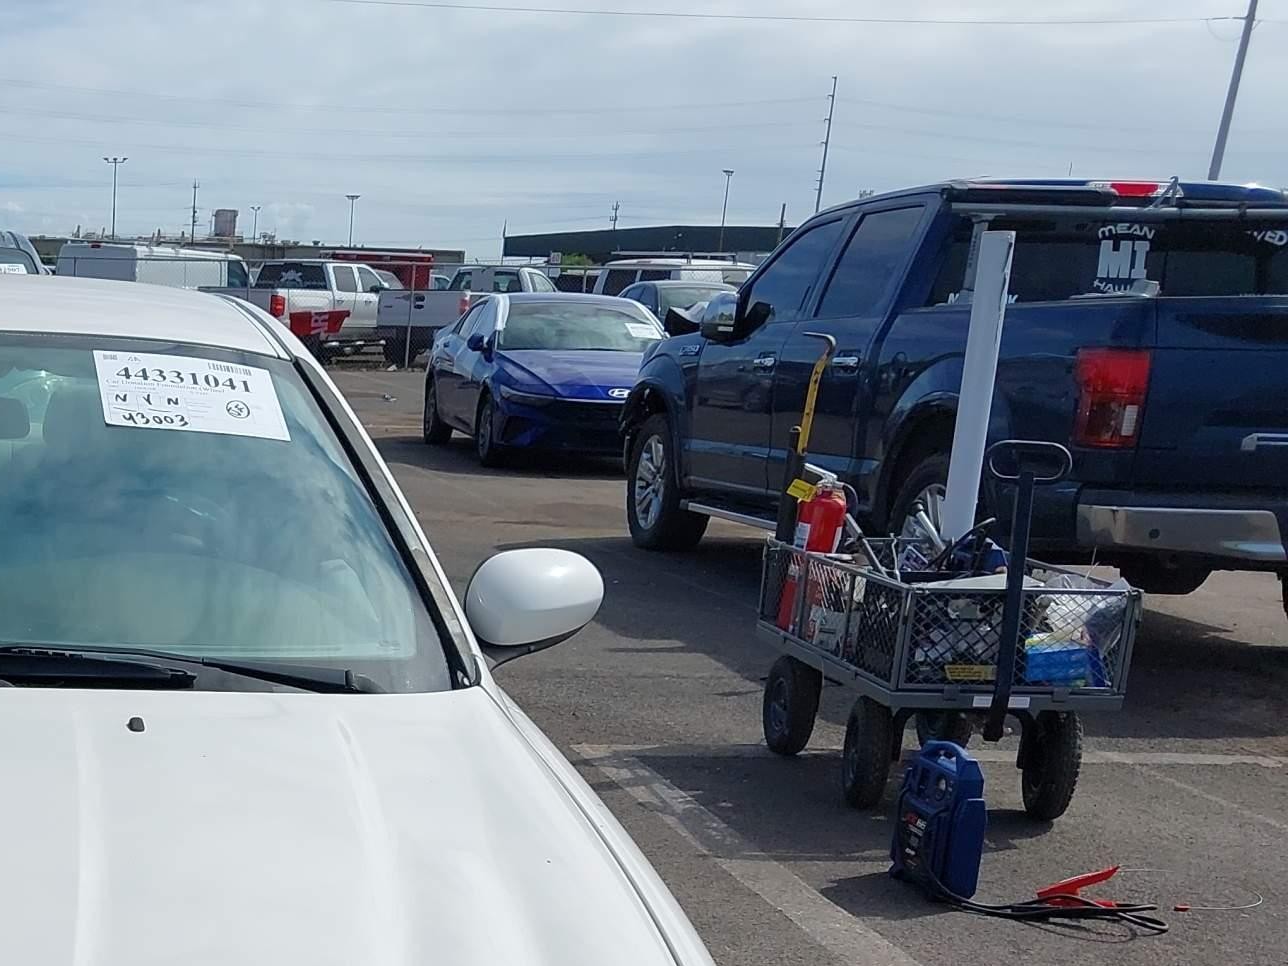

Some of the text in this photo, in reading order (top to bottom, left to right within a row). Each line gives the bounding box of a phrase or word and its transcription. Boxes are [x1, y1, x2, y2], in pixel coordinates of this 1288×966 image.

[1098, 223, 1156, 239] MEAN
[1097, 240, 1150, 278] MI
[116, 366, 253, 393] 44331041
[115, 393, 127, 403] N
[167, 397, 179, 405] N
